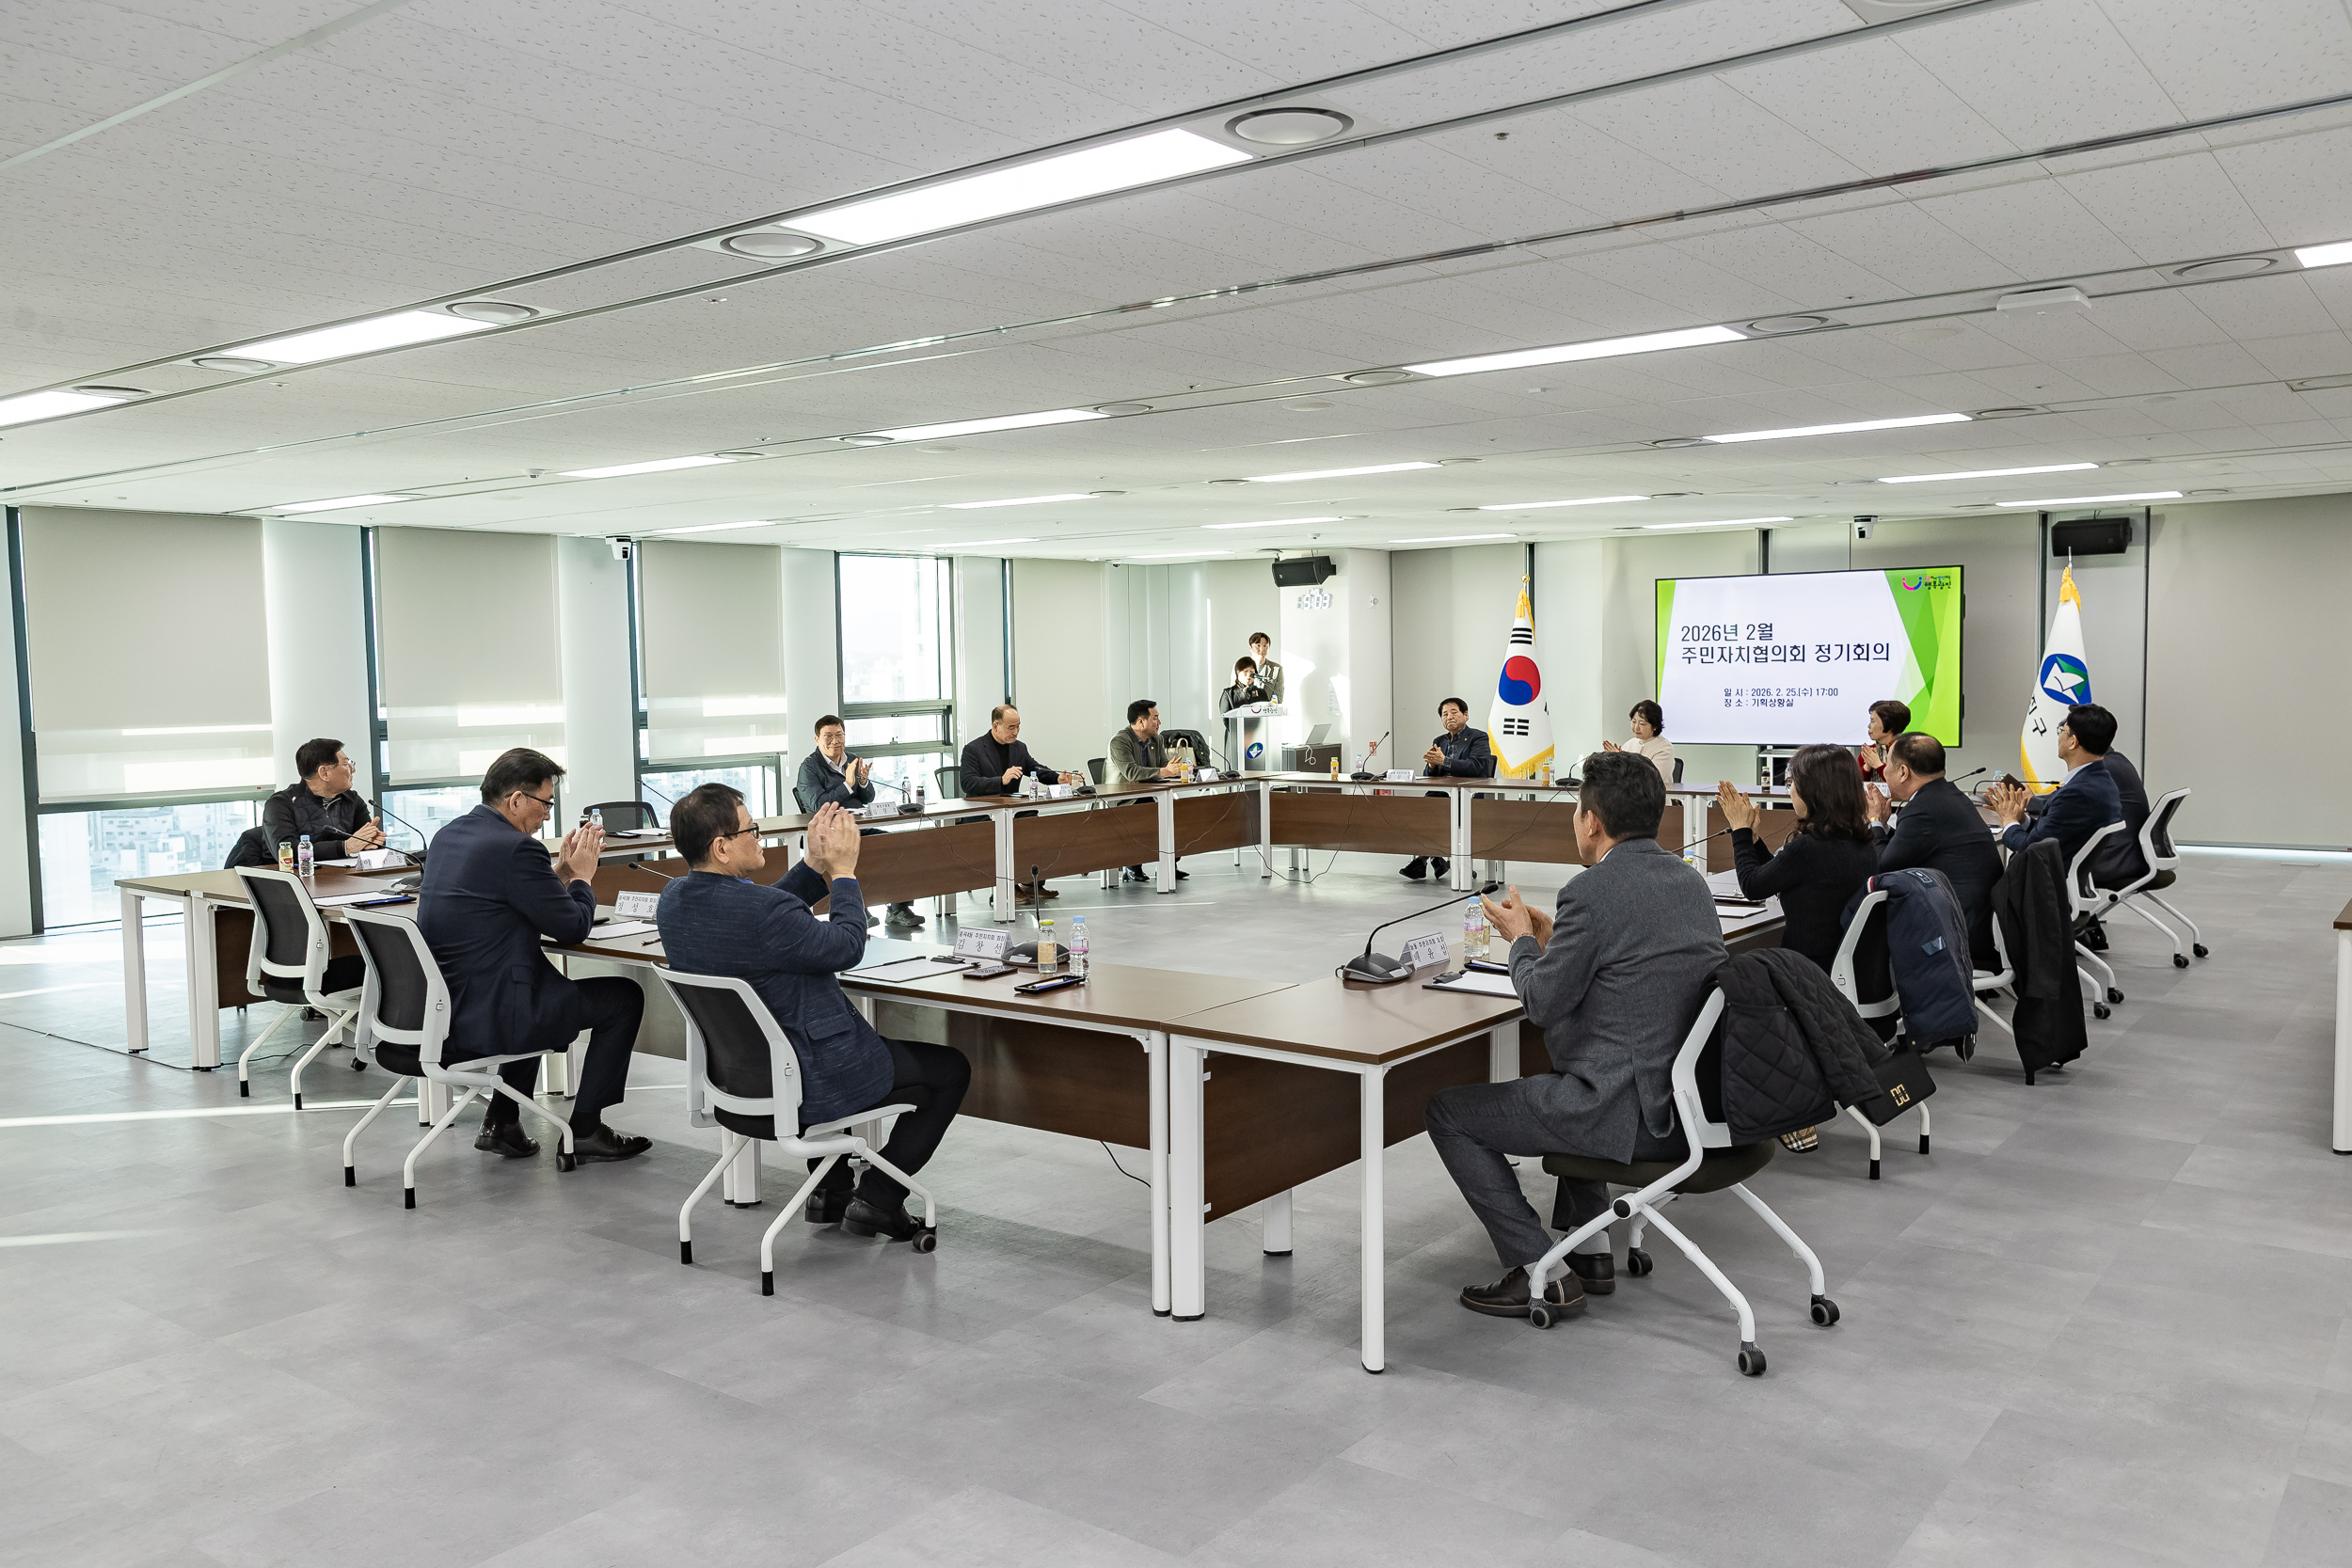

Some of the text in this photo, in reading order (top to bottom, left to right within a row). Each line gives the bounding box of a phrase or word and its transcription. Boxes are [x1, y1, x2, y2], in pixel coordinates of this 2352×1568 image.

[1681, 623, 1772, 641] 2026년 2월
[1681, 642, 1889, 664] 주민자치협의회 정기회의
[1724, 688, 1732, 697] 일
[1735, 688, 1743, 697] 시
[1751, 688, 1773, 697] 2026.
[1775, 688, 1783, 697] 2.
[1816, 688, 1838, 697] 17:00
[1724, 698, 1732, 707] 장
[1735, 698, 1743, 707] 소
[1751, 698, 1794, 707] 기획상황실
[957, 938, 965, 950] 김
[1427, 947, 1435, 959] 윤
